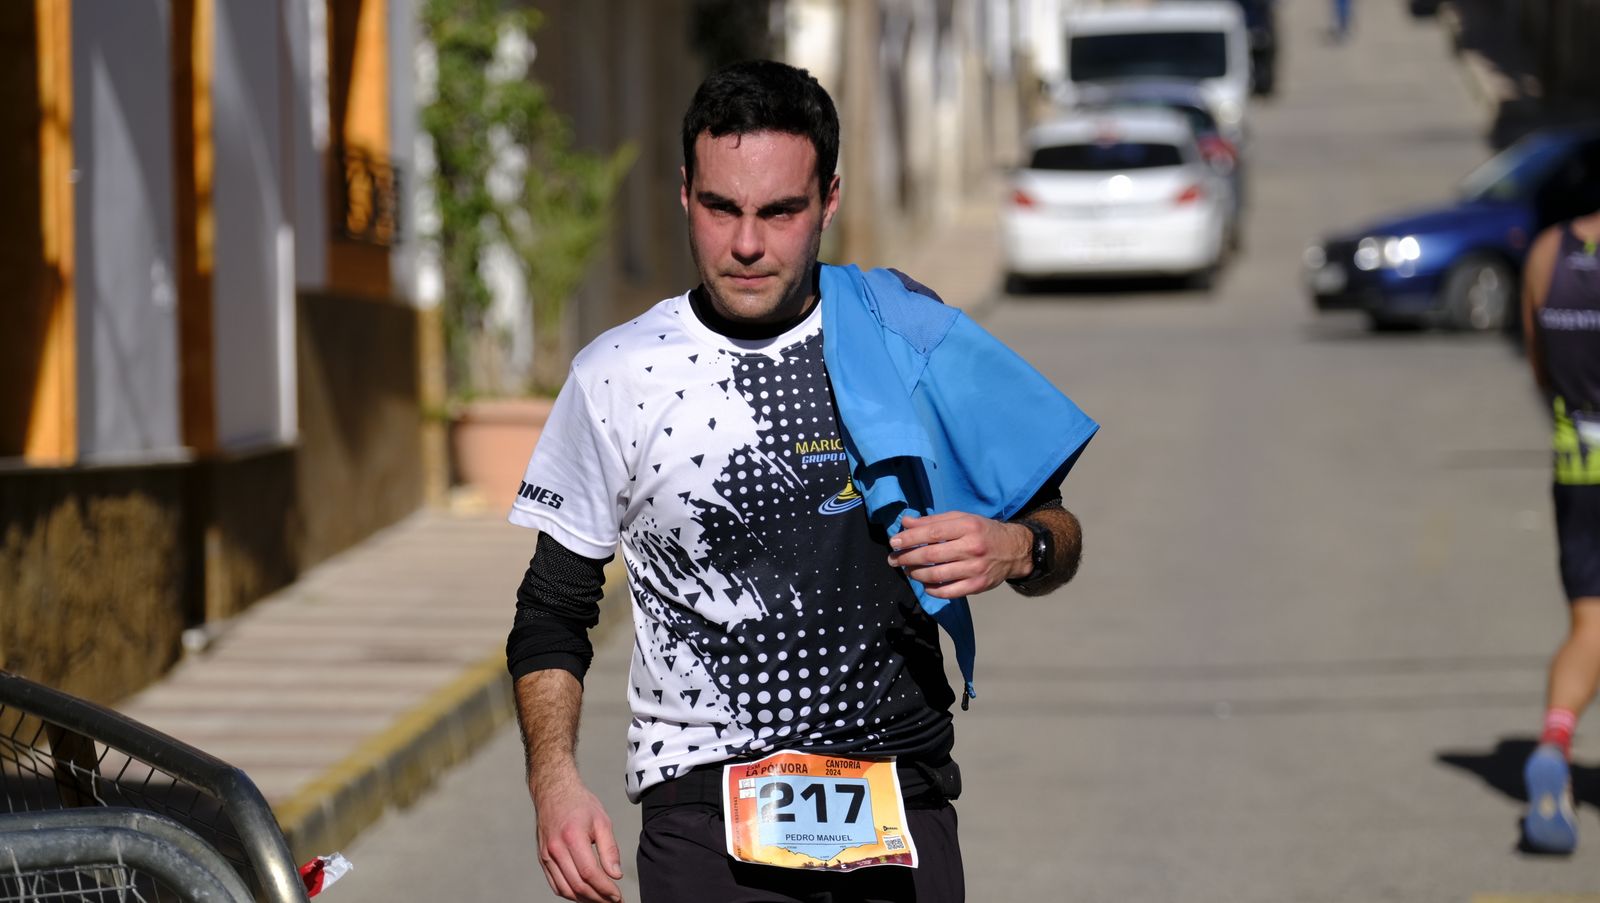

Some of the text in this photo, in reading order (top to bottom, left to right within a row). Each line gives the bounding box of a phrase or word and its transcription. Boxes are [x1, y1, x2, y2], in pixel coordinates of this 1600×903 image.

[802, 453, 838, 464] GRUPO
[825, 759, 862, 770] CANTORIA
[745, 769, 759, 777] LA
[825, 768, 842, 776] 2024
[759, 782, 866, 824] 217
[785, 833, 853, 842] PEDRO MANUEL
